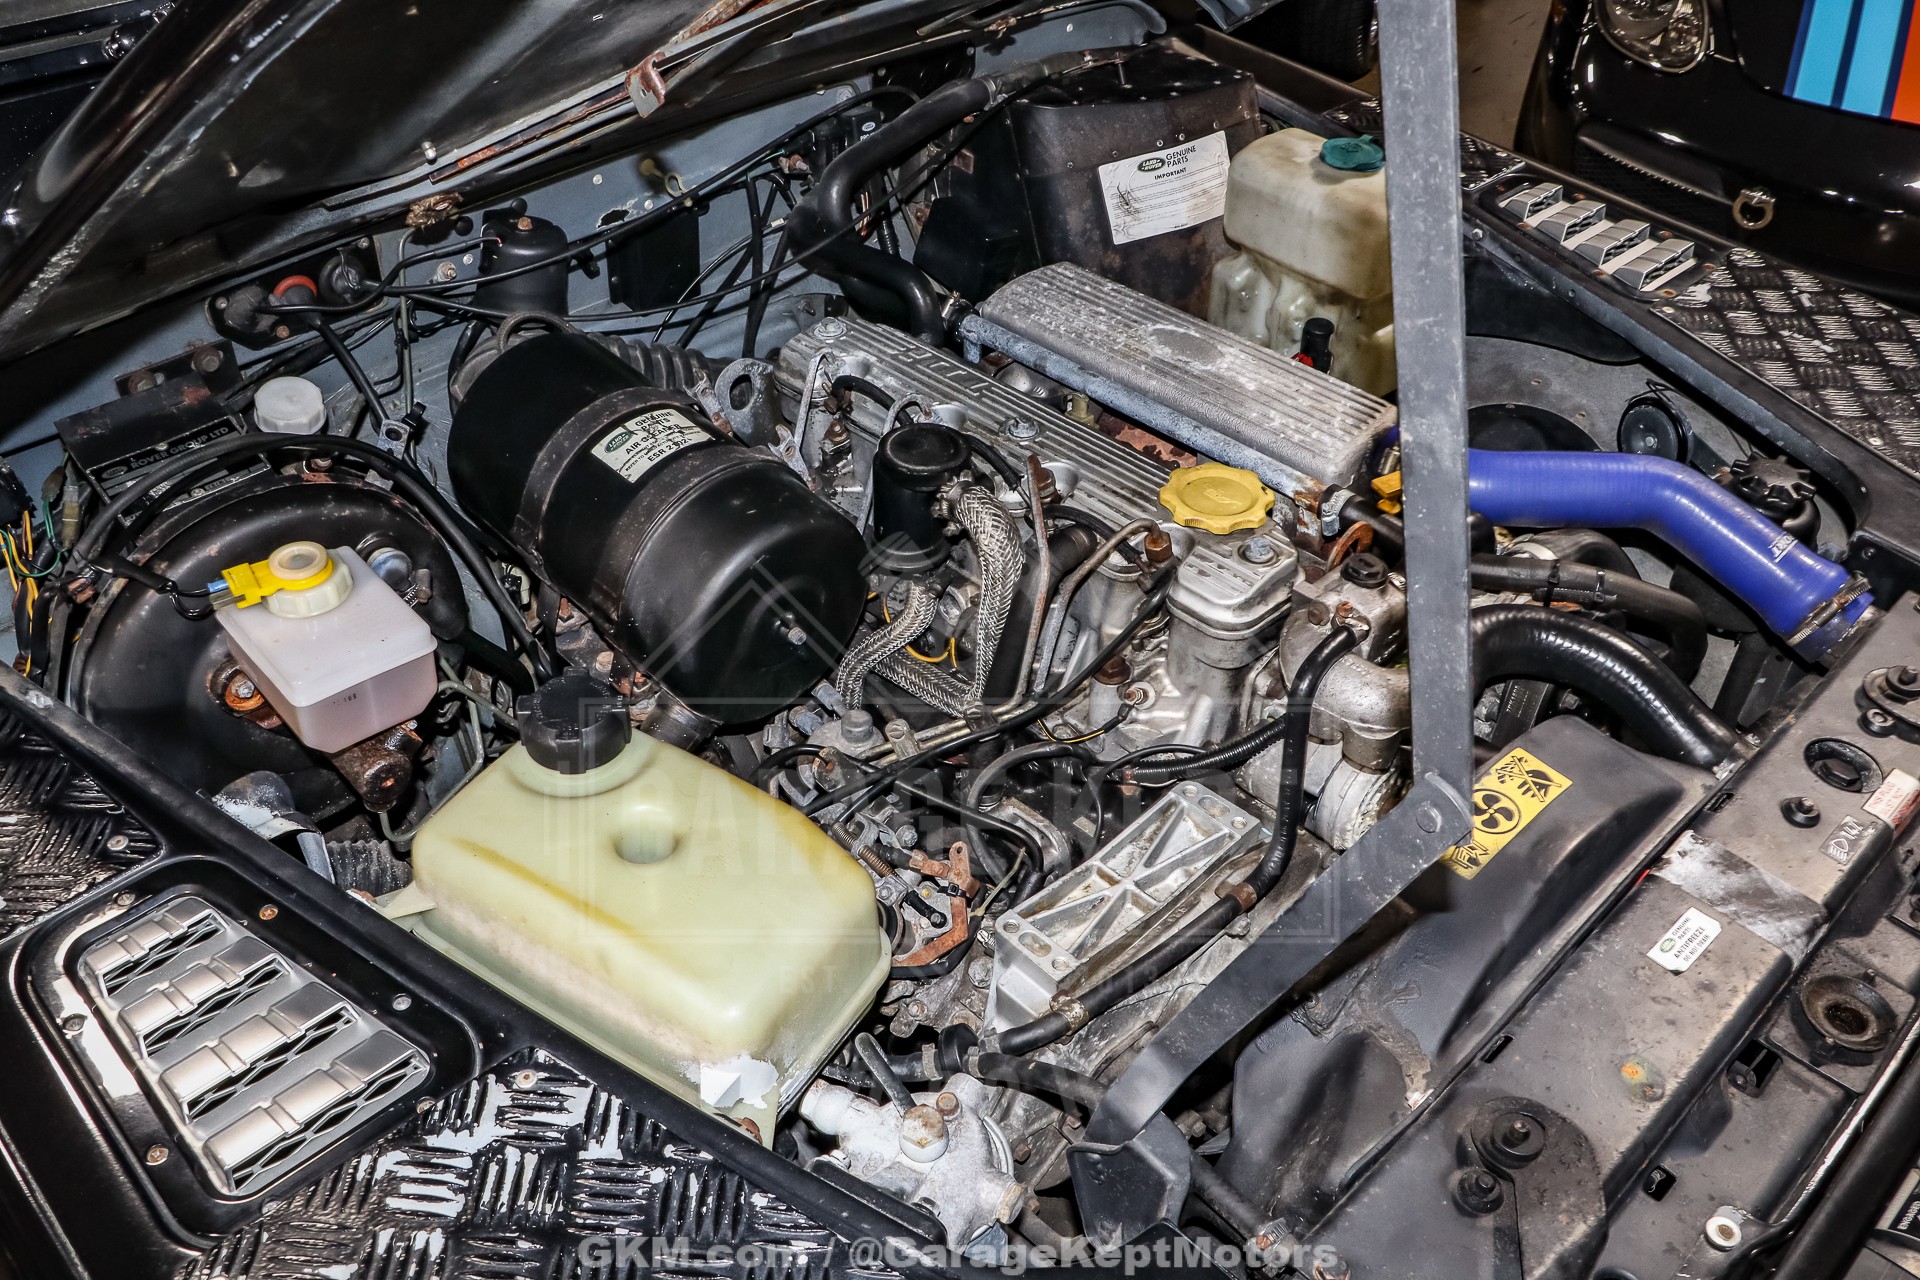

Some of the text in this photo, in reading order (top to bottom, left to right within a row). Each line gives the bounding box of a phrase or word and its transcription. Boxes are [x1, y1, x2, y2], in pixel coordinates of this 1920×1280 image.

[1165, 145, 1197, 160] GENUINE
[1166, 155, 1189, 168] PARTS
[1154, 167, 1187, 180] IMPORTANT
[130, 427, 229, 470] ROVER GROUP LTD
[625, 441, 641, 455] AIR
[647, 448, 666, 462] ESR
[1673, 926, 1706, 959] ANTIFREEZE
